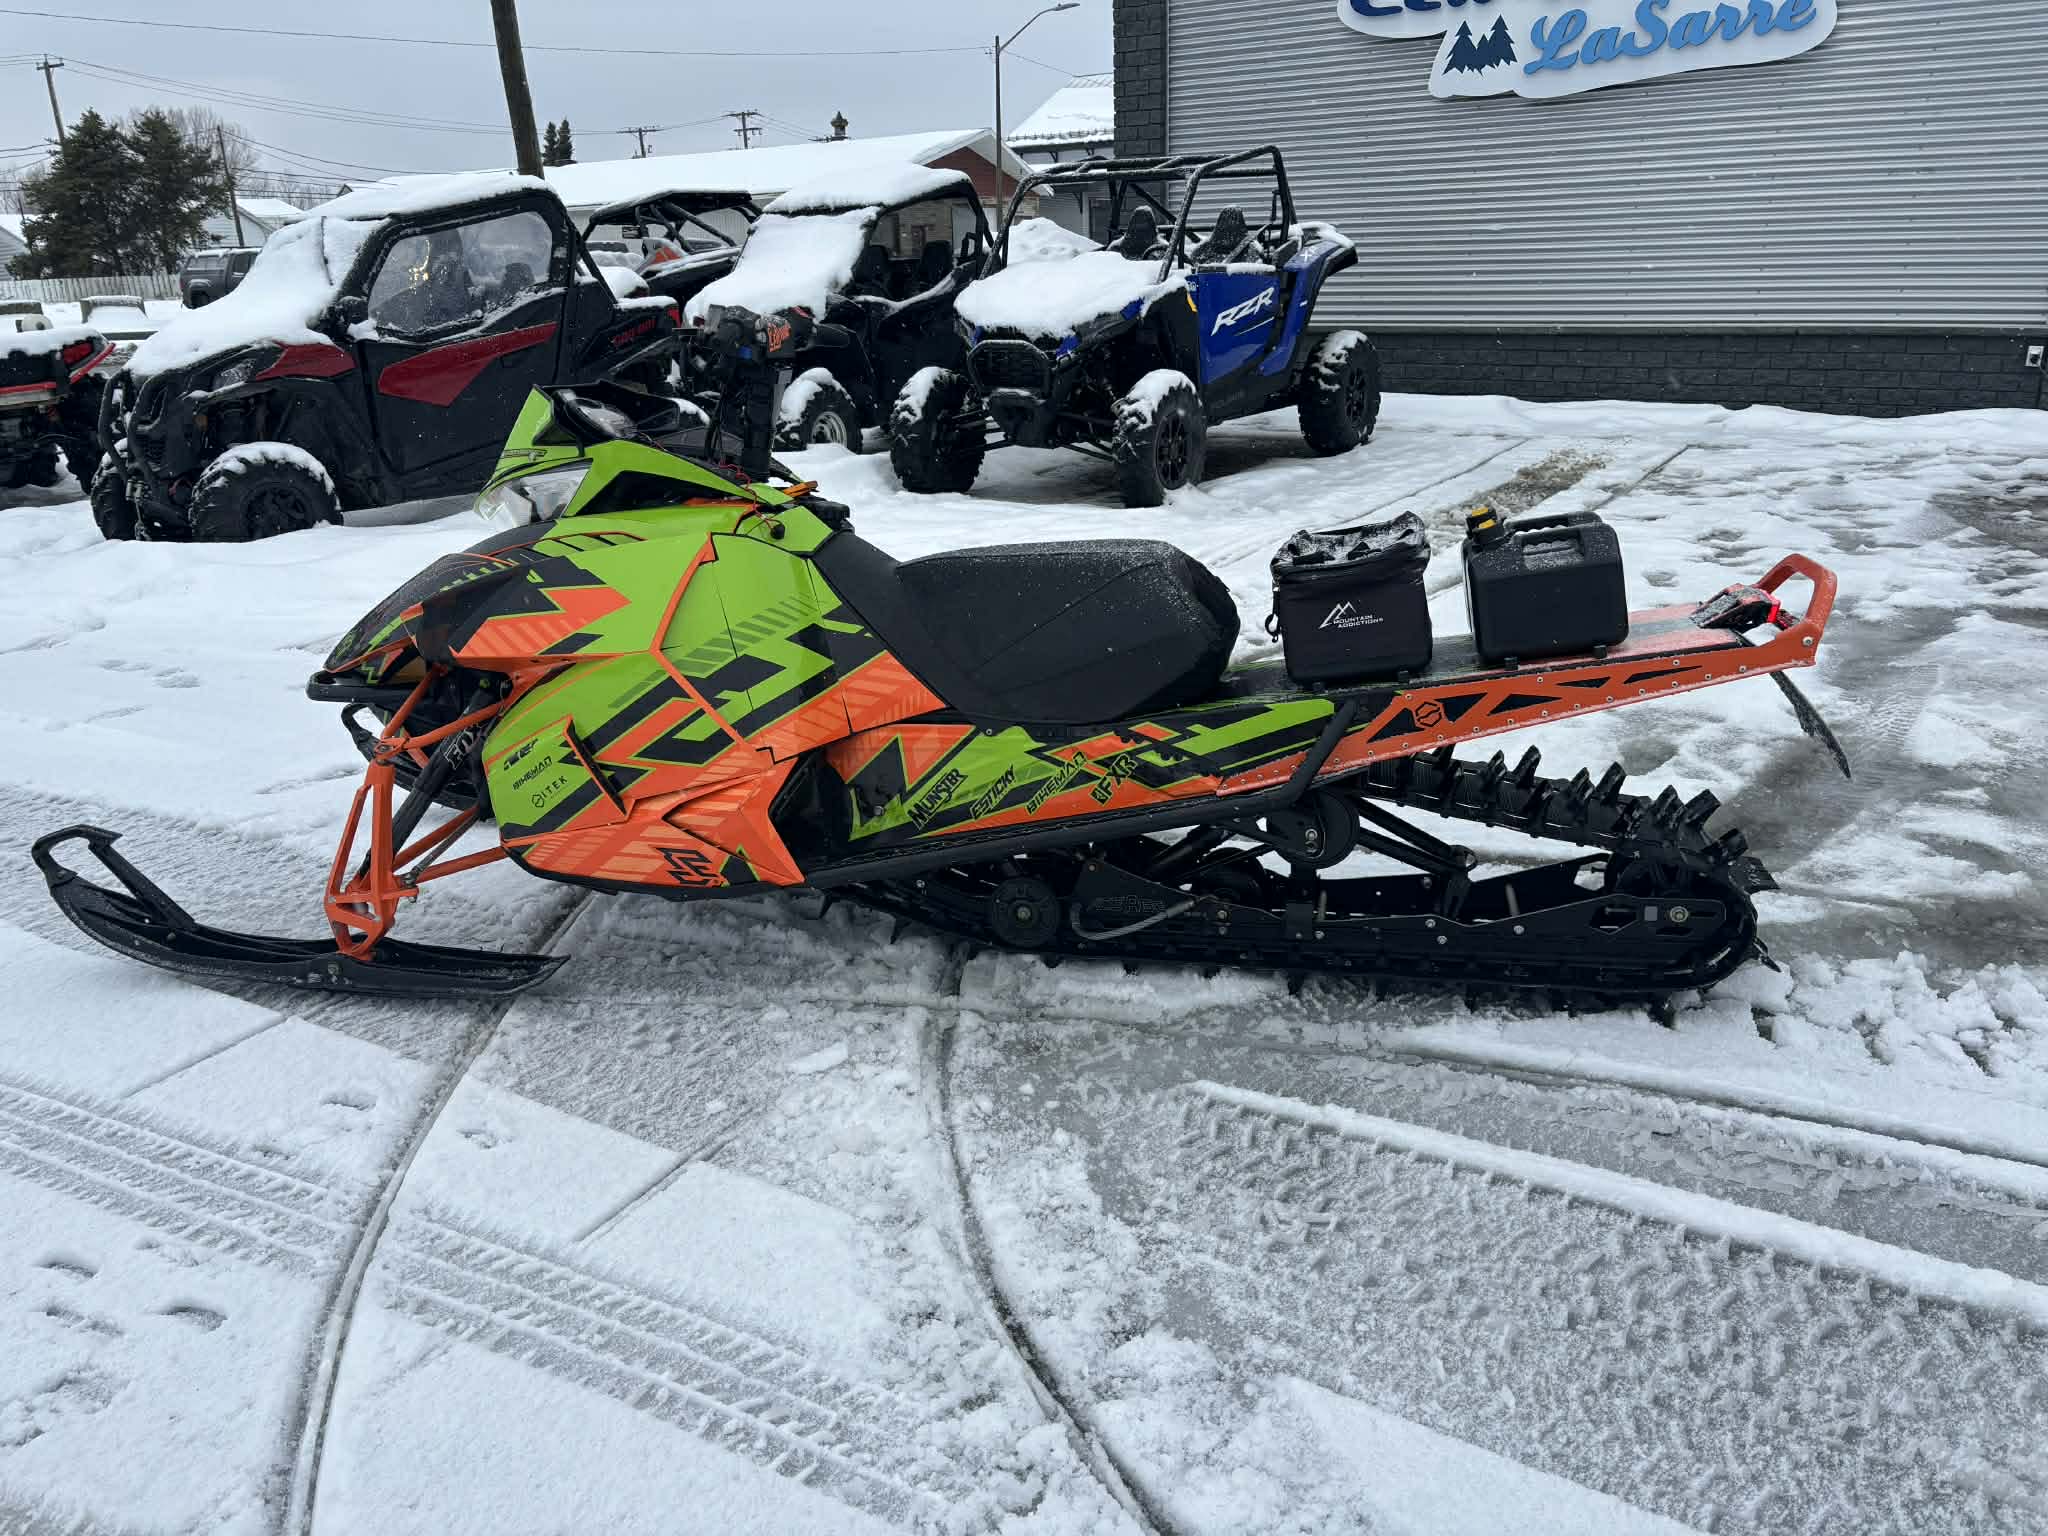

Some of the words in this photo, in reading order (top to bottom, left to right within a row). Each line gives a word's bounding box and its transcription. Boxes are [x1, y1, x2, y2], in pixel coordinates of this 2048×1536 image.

[1210, 286, 1275, 336] RZR
[1333, 614, 1373, 624] MOUNTAIN
[1337, 618, 1384, 628] ADDICTIONS
